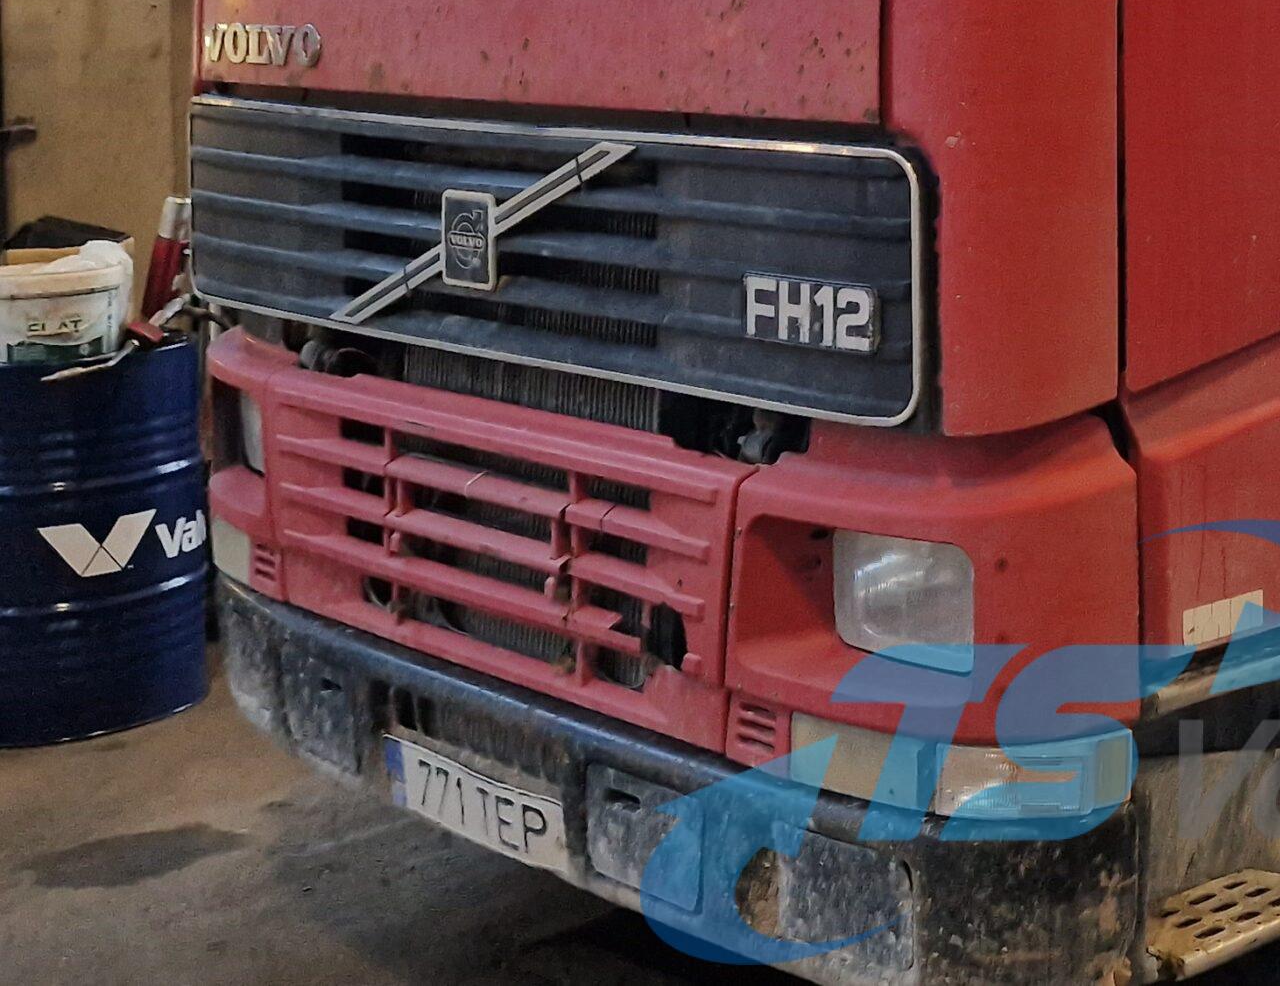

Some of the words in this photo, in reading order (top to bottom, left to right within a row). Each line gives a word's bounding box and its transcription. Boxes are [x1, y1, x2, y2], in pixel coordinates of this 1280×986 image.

[205, 22, 322, 67] VOLVO
[449, 233, 483, 249] VOLVO
[746, 275, 871, 352] FH12
[418, 758, 465, 825] 771
[476, 786, 548, 854] TEP
